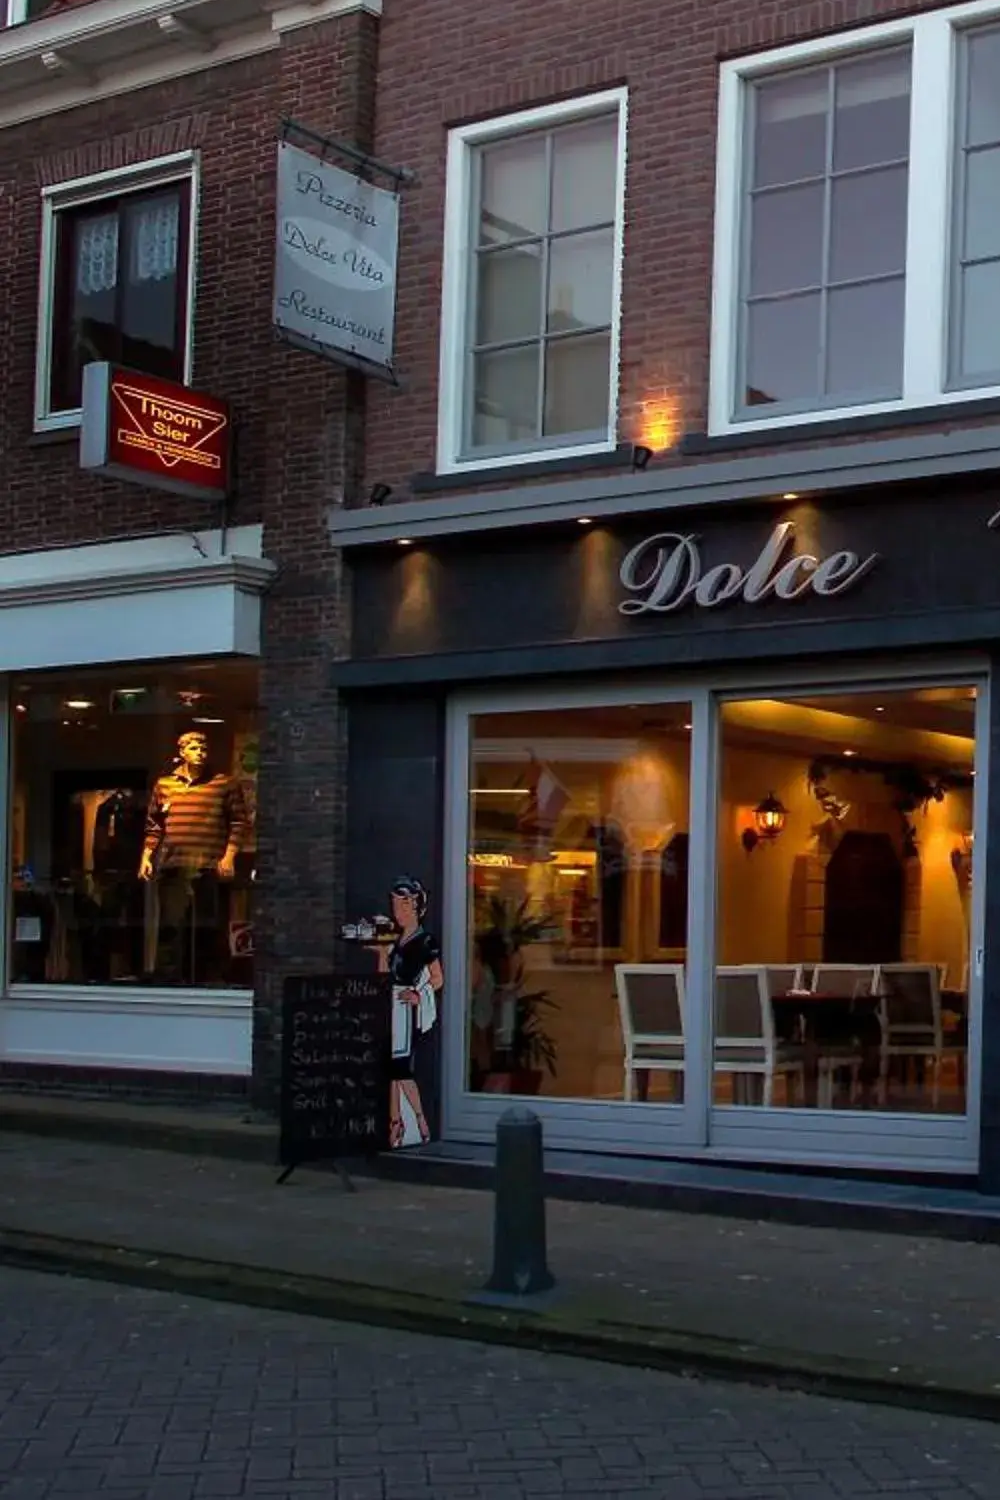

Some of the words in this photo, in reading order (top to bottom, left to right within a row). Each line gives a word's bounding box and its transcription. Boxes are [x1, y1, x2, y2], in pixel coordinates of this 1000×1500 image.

[296, 171, 377, 227] Pizzeria
[284, 220, 336, 265] Dolce
[343, 248, 385, 282] Vita
[279, 289, 385, 345] Restaurant
[140, 397, 202, 429] Thoom
[618, 520, 880, 615] Dolce
